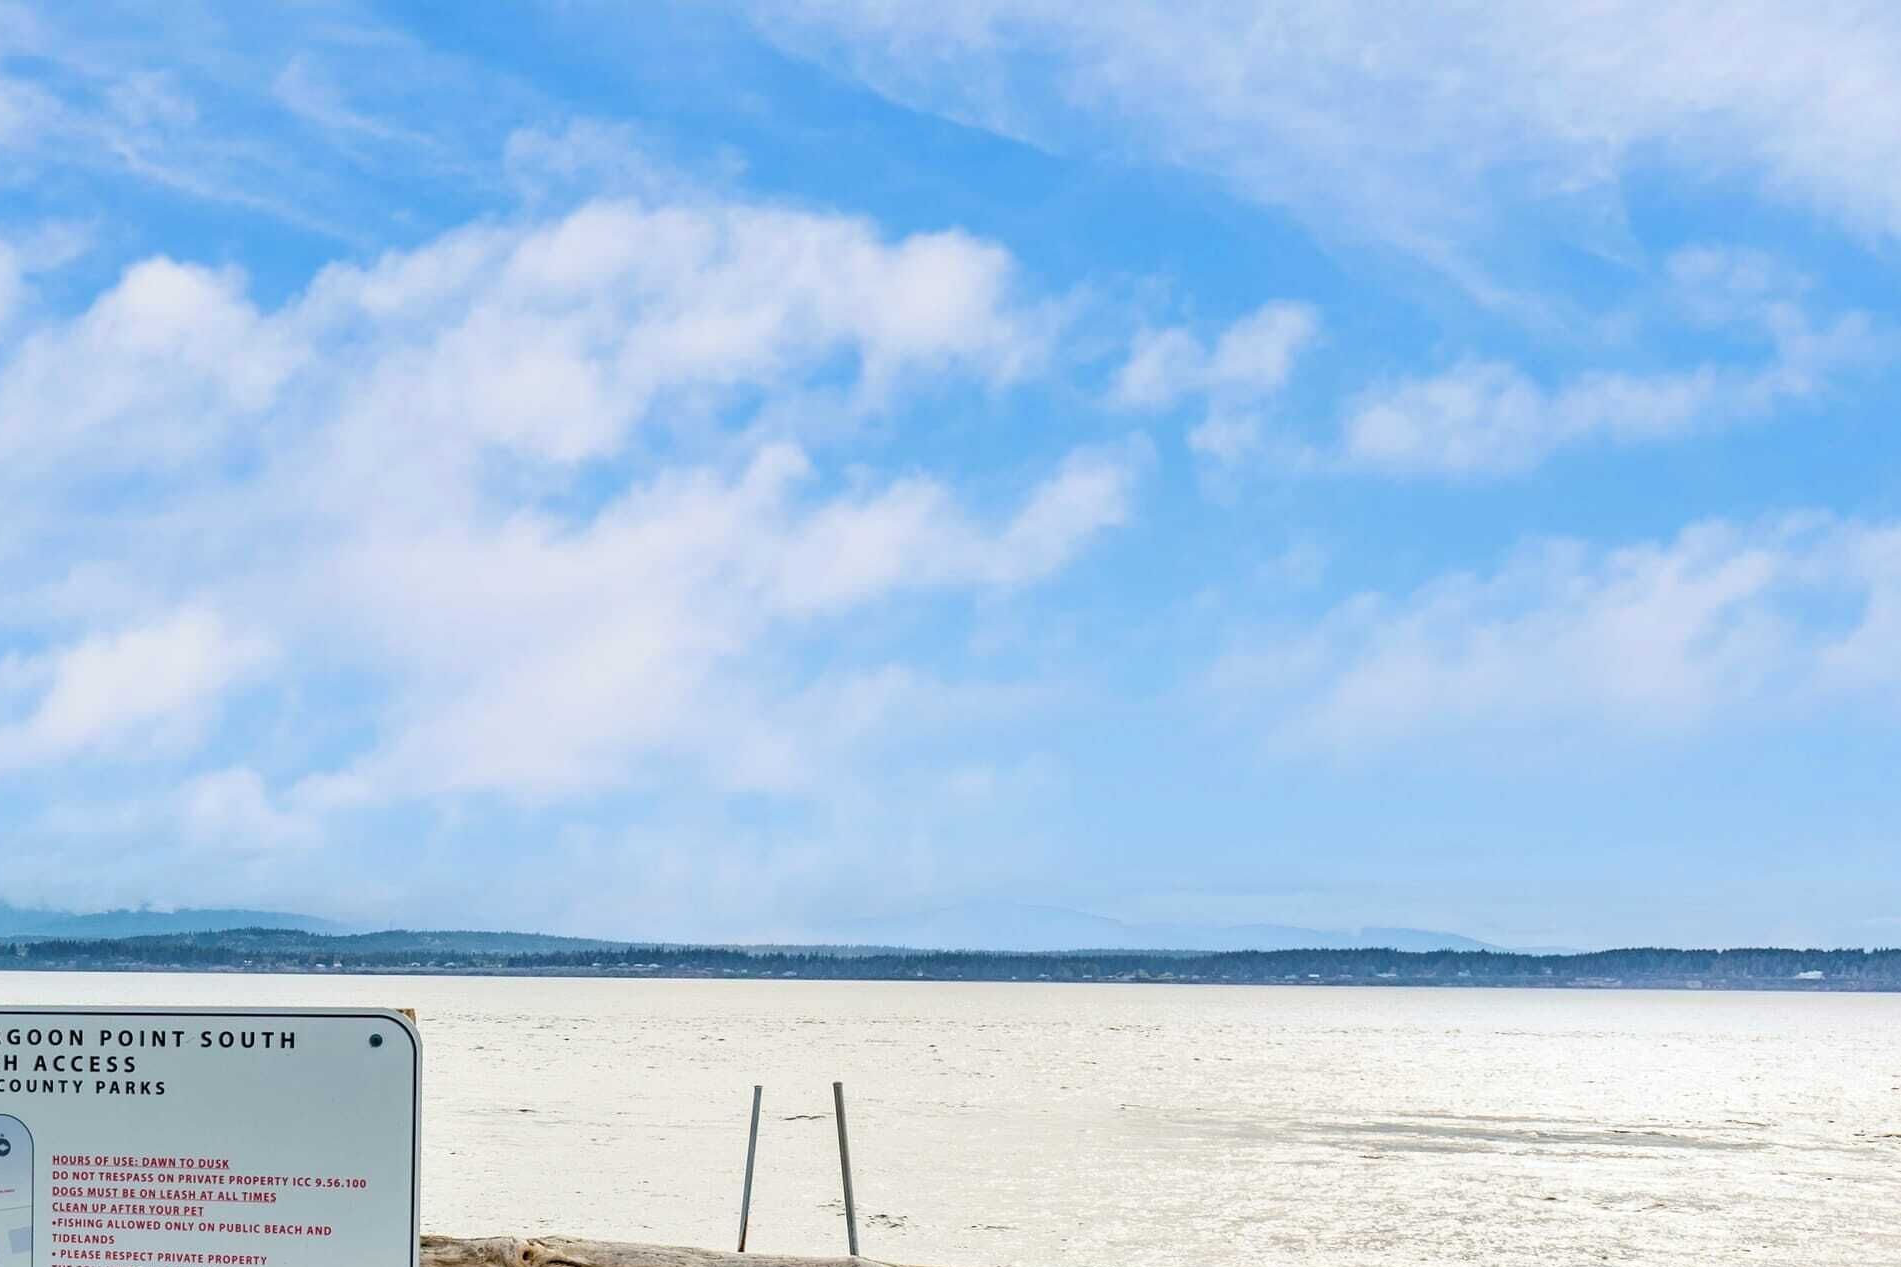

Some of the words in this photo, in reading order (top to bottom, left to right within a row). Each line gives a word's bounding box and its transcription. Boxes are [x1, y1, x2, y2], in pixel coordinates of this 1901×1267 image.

[100, 1030, 185, 1047] POINT
[201, 1031, 296, 1048] SOUTH
[33, 1055, 137, 1072] ACCESS
[95, 1080, 166, 1095] PARKS
[52, 1156, 90, 1165] HOURS
[95, 1157, 109, 1166] OF
[113, 1157, 138, 1166] USE:
[142, 1158, 176, 1167] DAWN
[180, 1158, 194, 1167] TO
[198, 1159, 229, 1168] DUSK
[52, 1171, 68, 1180] DO
[72, 1172, 95, 1181] NOT
[99, 1172, 153, 1182] TRESPASS
[158, 1174, 174, 1183] ON
[178, 1174, 225, 1184] PRIVATE
[229, 1176, 288, 1186] PROPERTY
[293, 1177, 311, 1187] ICC
[315, 1178, 366, 1188] 9.56.100
[52, 1187, 83, 1197] DOGS
[87, 1188, 118, 1198] MUST
[122, 1189, 135, 1198] BE
[139, 1189, 156, 1199] ON
[160, 1190, 196, 1200] LEASH
[200, 1191, 214, 1200] AT
[218, 1191, 238, 1201] ALL
[242, 1192, 276, 1202] TIMES
[52, 1203, 88, 1213] CLEAN
[92, 1204, 106, 1213] UP
[110, 1204, 145, 1214] AFTER
[149, 1205, 180, 1215] YOUR
[183, 1206, 204, 1216] PET
[107, 1220, 161, 1231] ALLOWED
[165, 1221, 194, 1231] ONLY
[198, 1222, 215, 1232] ON
[219, 1223, 260, 1233] PUBLIC
[264, 1224, 302, 1234] BEACH
[306, 1225, 332, 1235] AND
[52, 1234, 115, 1245] TIDELANDS
[60, 1250, 101, 1260] PLEASE
[105, 1251, 153, 1261] RESPECT
[157, 1252, 204, 1263] PRIVATE
[208, 1254, 267, 1264] PROPERTY
